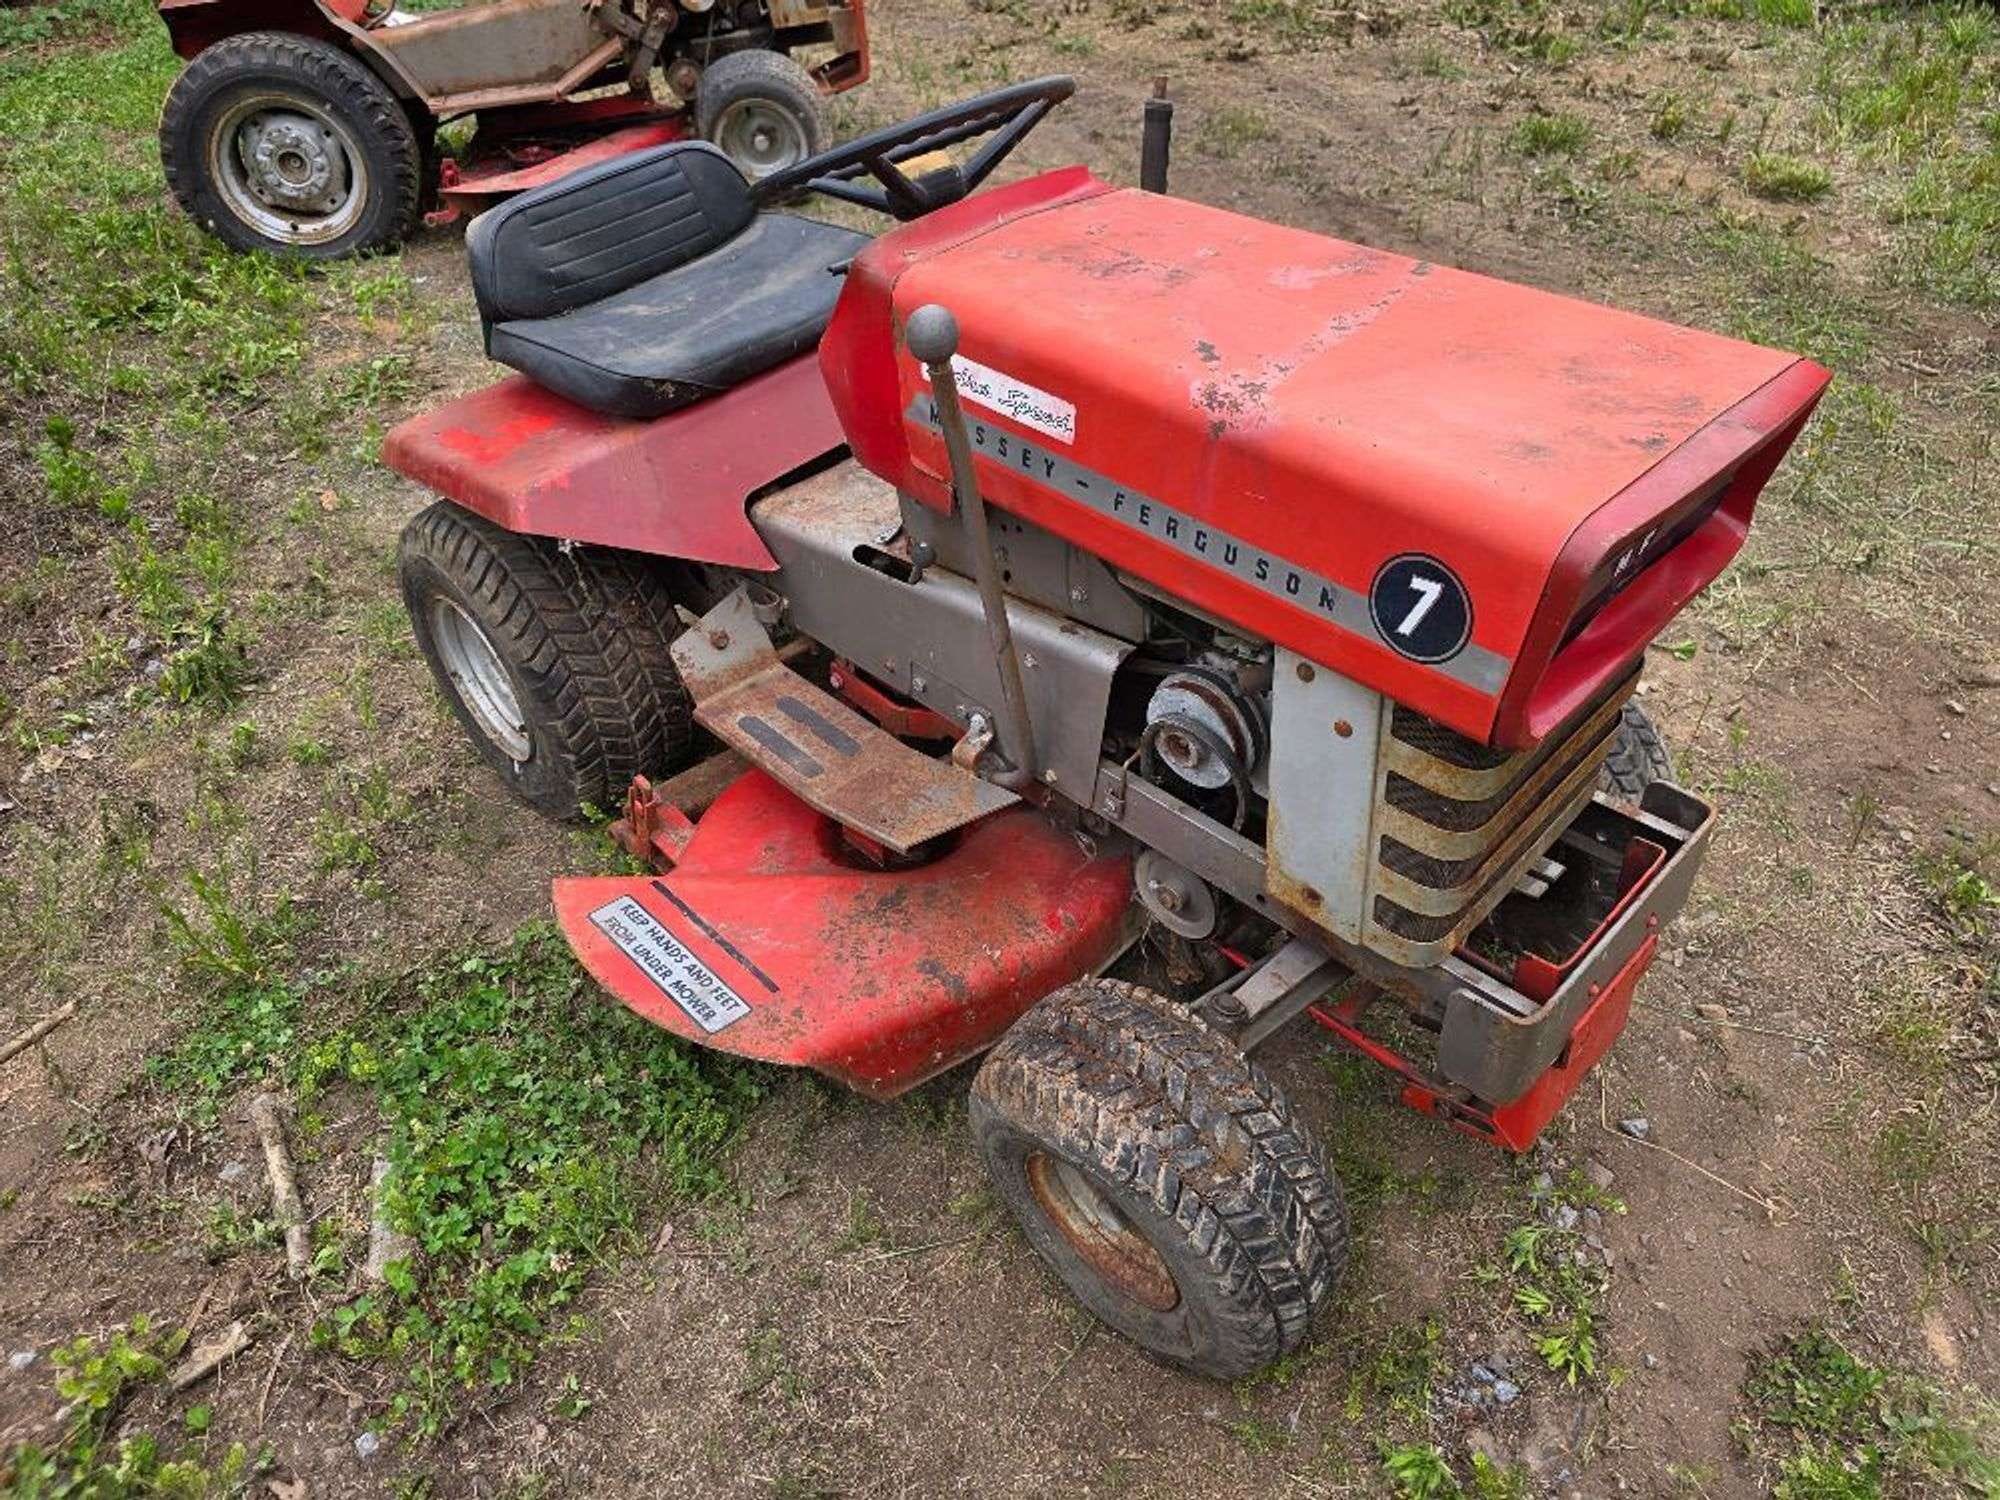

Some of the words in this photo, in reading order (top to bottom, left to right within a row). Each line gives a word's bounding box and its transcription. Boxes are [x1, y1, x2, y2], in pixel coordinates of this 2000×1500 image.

[1394, 572, 1446, 638] 7
[603, 915, 637, 945] FROM
[633, 944, 673, 981] UNDER
[670, 980, 716, 1022] MOWER
[620, 903, 649, 928] KEEP
[646, 925, 689, 963] HANDS
[683, 963, 713, 987] AND
[710, 986, 741, 1012] FEET
